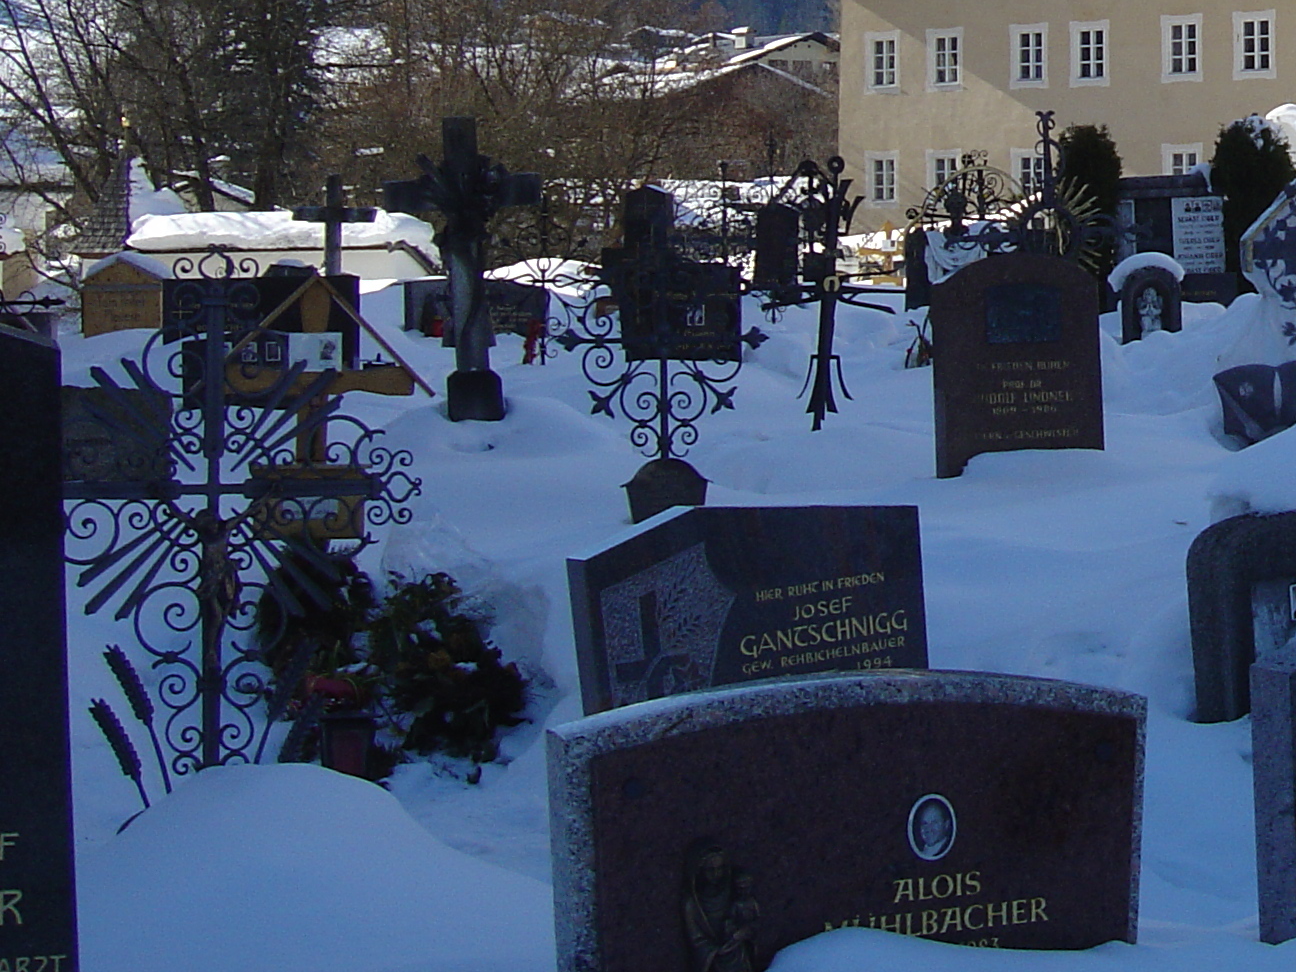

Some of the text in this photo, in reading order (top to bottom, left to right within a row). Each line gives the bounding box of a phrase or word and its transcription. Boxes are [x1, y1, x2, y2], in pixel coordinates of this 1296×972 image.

[755, 571, 885, 602] HIER RUHT IN FRIEDEN
[792, 596, 853, 622] JOSEF
[739, 609, 908, 659] GANTSCHNIGG
[856, 655, 893, 670] 1994
[893, 870, 982, 904] ALOIS
[824, 896, 1049, 937] HLBACHER
